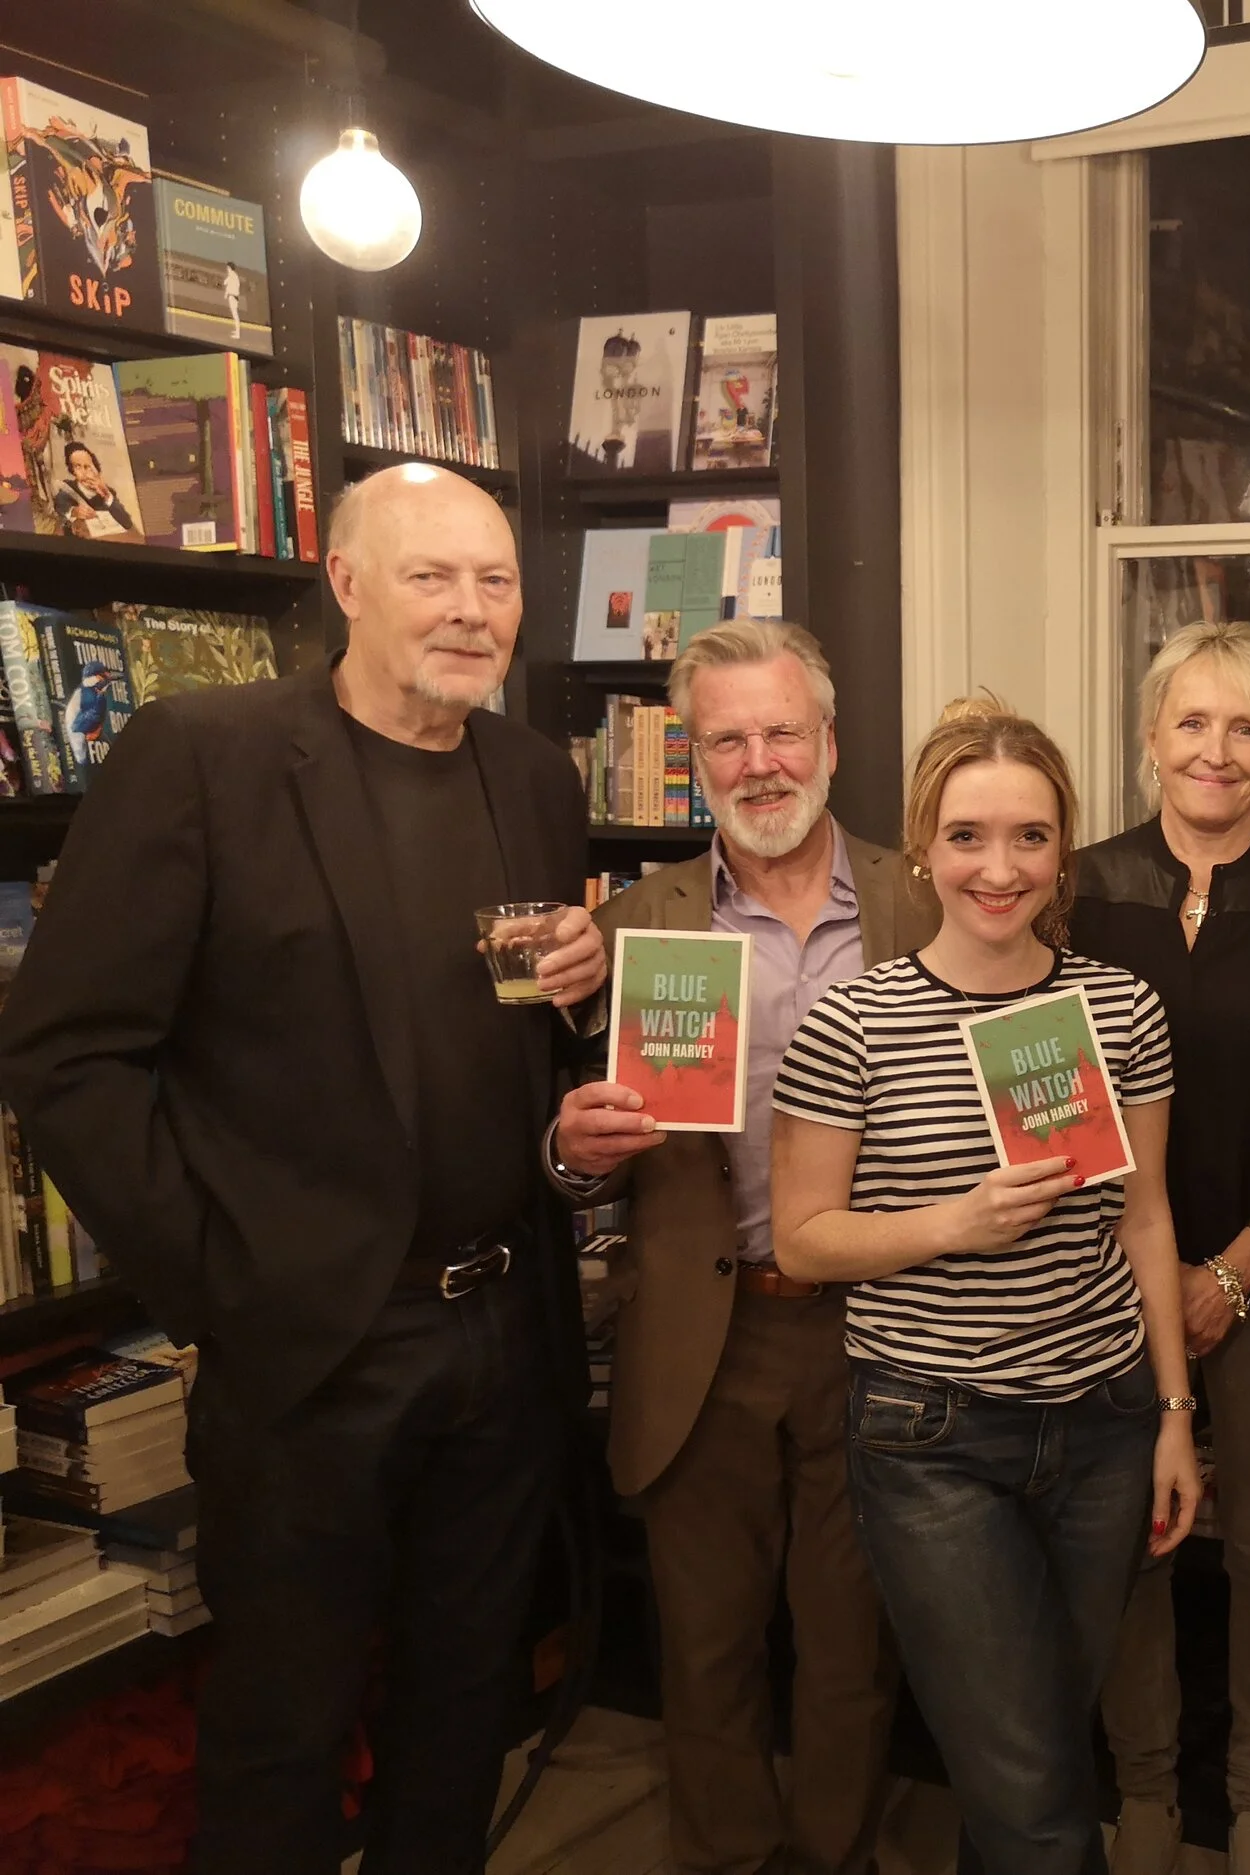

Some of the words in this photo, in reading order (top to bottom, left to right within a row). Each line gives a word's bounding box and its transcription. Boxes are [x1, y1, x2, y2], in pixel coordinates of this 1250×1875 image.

[13, 176, 29, 210] SKIP
[175, 198, 254, 235] COMMUTE
[595, 386, 661, 401] LONDON
[293, 440, 311, 464] THE
[294, 464, 315, 513] JUNGLE
[0, 609, 24, 660] TOM
[66, 625, 98, 641] RICHARD
[143, 616, 166, 631] The
[167, 619, 198, 636] Story
[6, 665, 37, 713] COX
[653, 973, 708, 1003] BLUE
[640, 1008, 716, 1039] WATCH
[640, 1042, 671, 1057] JOHN
[673, 1043, 715, 1059] HARVEY
[1011, 1036, 1066, 1077] BLUE
[1008, 1067, 1085, 1113] WATCH
[1022, 1113, 1050, 1131] JOHN
[1050, 1098, 1089, 1123] HARVEY
